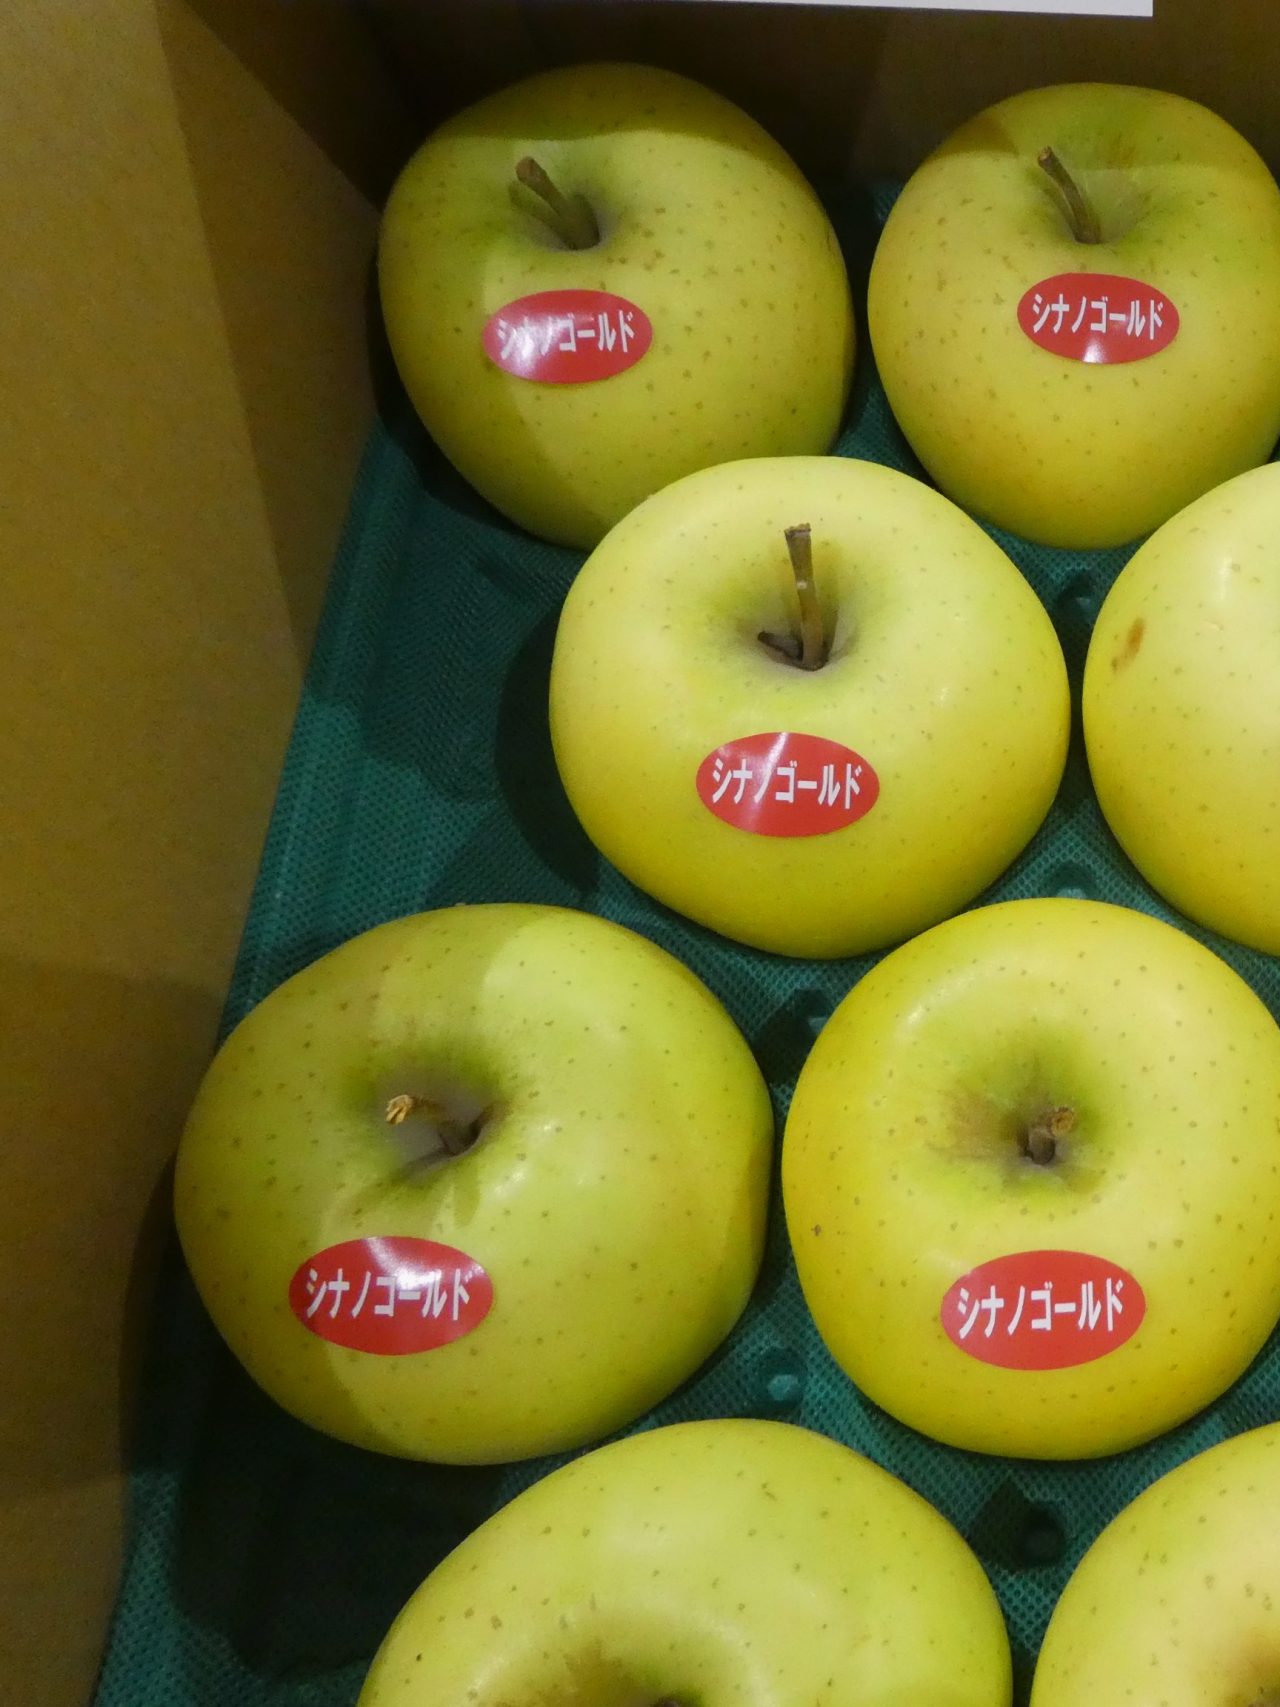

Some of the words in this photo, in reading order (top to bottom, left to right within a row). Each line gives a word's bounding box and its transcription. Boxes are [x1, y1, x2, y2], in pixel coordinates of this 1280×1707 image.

[1033, 293, 1163, 340] シナノゴールド
[712, 758, 863, 810] シナノゴールド
[306, 1268, 473, 1321] シナノゴールド
[957, 1277, 1123, 1339] シナノゴールド
